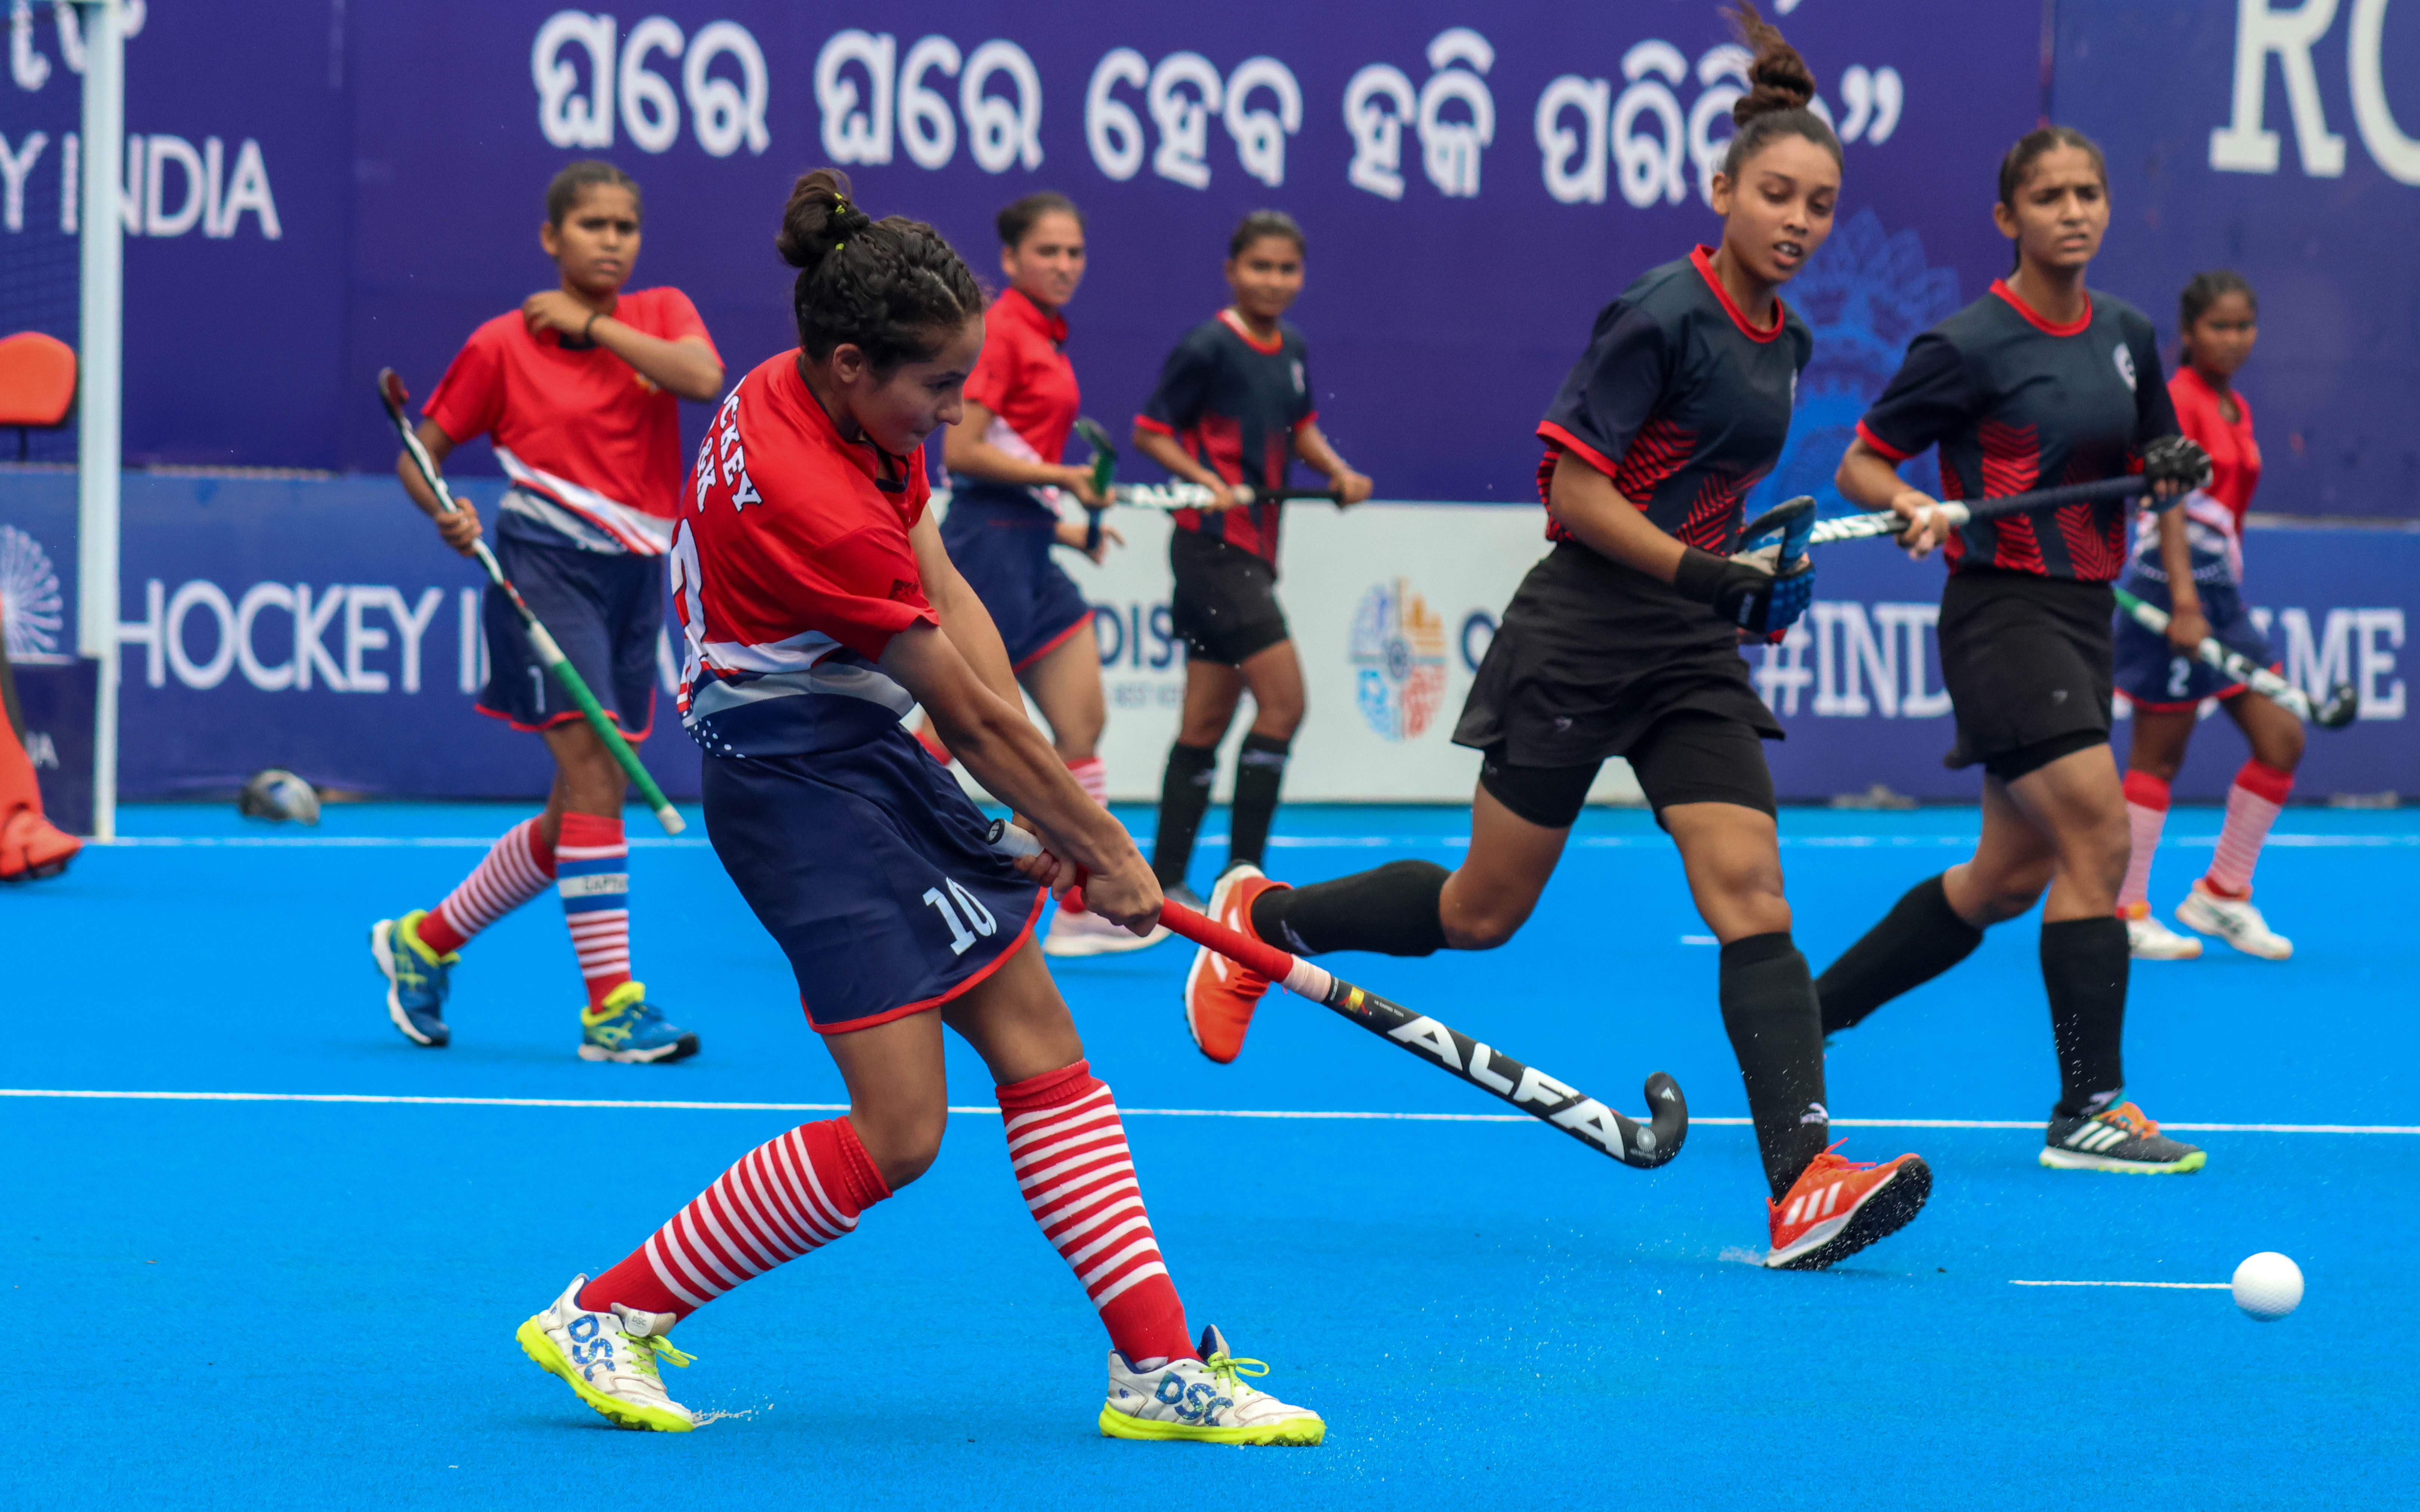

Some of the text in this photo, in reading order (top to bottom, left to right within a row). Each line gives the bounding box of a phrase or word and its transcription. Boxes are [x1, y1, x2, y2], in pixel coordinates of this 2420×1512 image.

[531, 10, 770, 157] ଘରେ
[814, 29, 1044, 173] ଘରେ
[719, 375, 763, 514] CKEY
[116, 578, 444, 693] HOCKEY
[2168, 656, 2190, 698] 2
[922, 877, 998, 956] 10
[1388, 1015, 1625, 1161] ALFA
[567, 1313, 617, 1382] DSC
[632, 1315, 646, 1326] DSC
[1155, 1370, 1234, 1426] DSC
